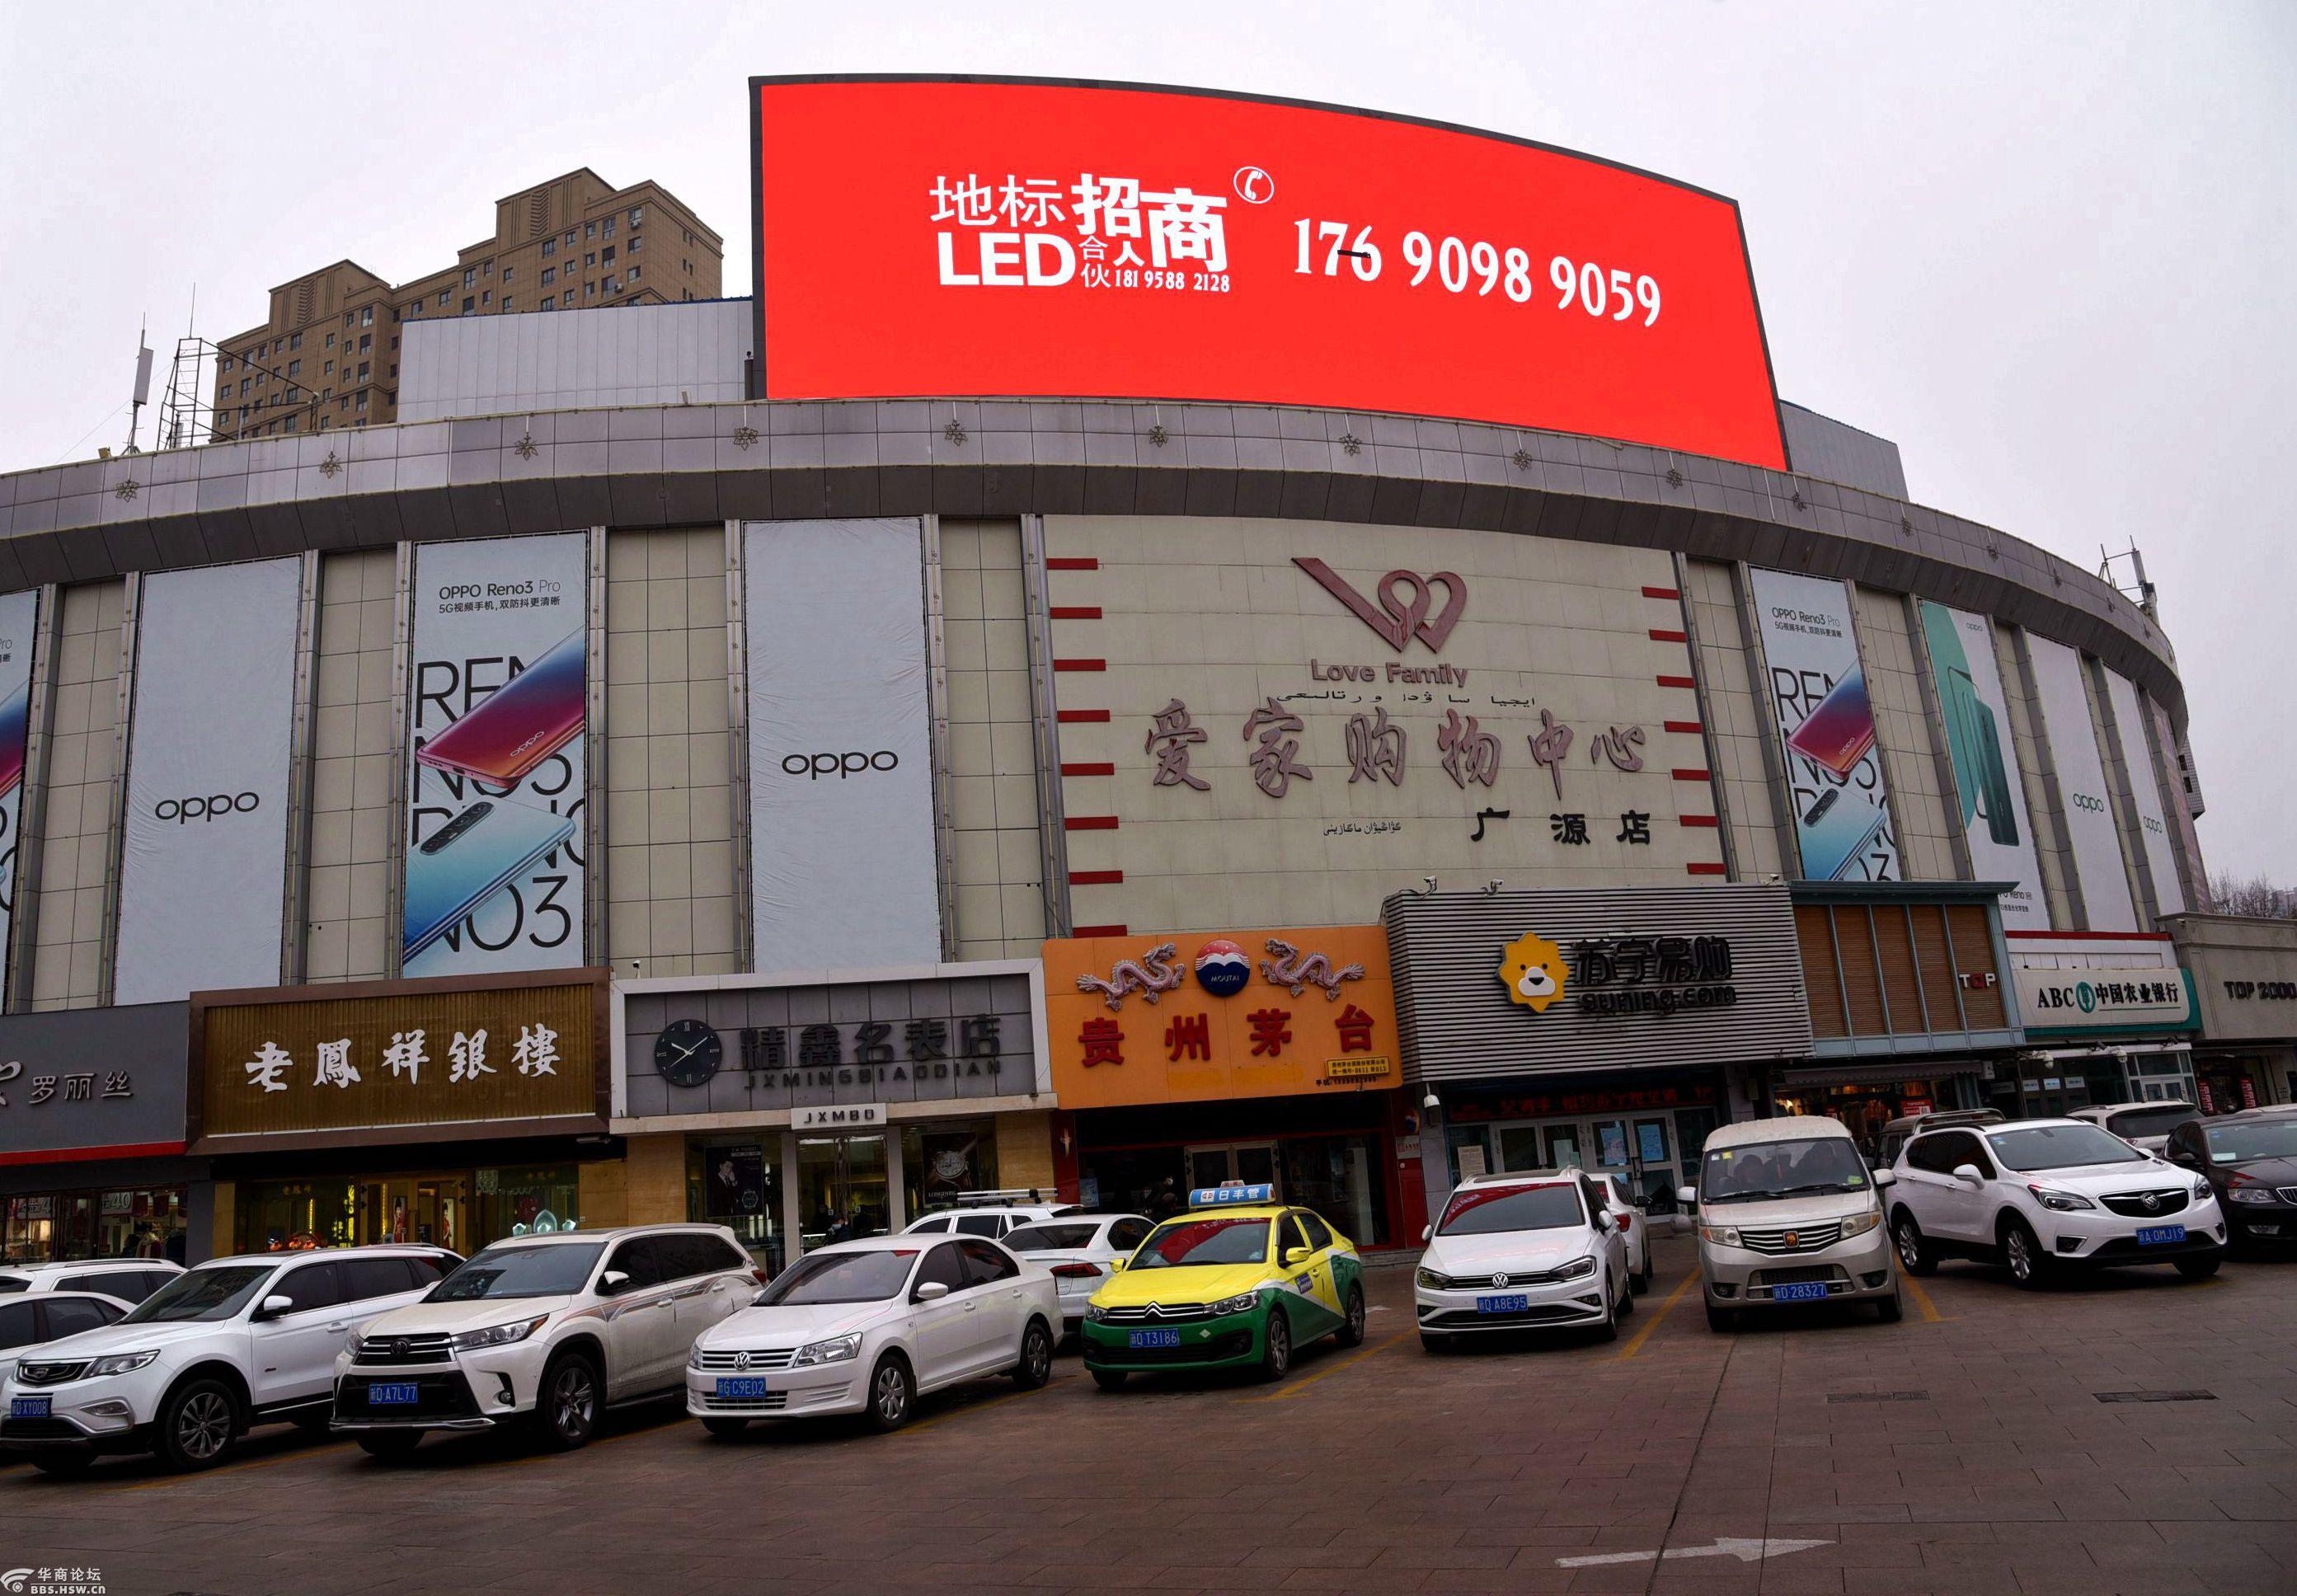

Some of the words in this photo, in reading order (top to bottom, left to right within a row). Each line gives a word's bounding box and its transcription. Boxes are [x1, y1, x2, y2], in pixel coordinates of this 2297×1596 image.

[937, 232, 1076, 286] LED
[1294, 218, 1382, 282] 176
[1402, 231, 1532, 303] 9098
[1550, 256, 1661, 327] 9059
[1115, 270, 1138, 288] 181
[1144, 270, 1185, 289] 9588
[1193, 273, 1229, 293] 2128
[439, 584, 481, 600] OPPO
[487, 580, 533, 597] Reno3
[539, 579, 561, 593] Pro
[1772, 607, 1797, 621] OPPO
[1798, 611, 1825, 625] Reno3
[1827, 614, 1840, 627] Pro
[1966, 622, 1983, 632] oppo
[1311, 659, 1375, 683] Love
[1385, 661, 1468, 688] Family
[510, 730, 545, 757] oppo
[1144, 697, 1646, 802] 爱家购物中心
[782, 750, 899, 781] oppo
[155, 791, 260, 824] oppo
[2073, 792, 2105, 814] oppo
[1471, 807, 1651, 846] 广源店
[2144, 815, 2163, 834] oppo
[1210, 974, 1240, 983] MOUTAI
[2224, 981, 2255, 1000] TOP
[2037, 987, 2075, 1008] ABC
[2094, 981, 2179, 1005] 中国农业银行
[1078, 1003, 1374, 1068] 贵州茅台
[28, 1071, 133, 1105] 罗丽丝
[803, 1109, 875, 1124] JXMBD
